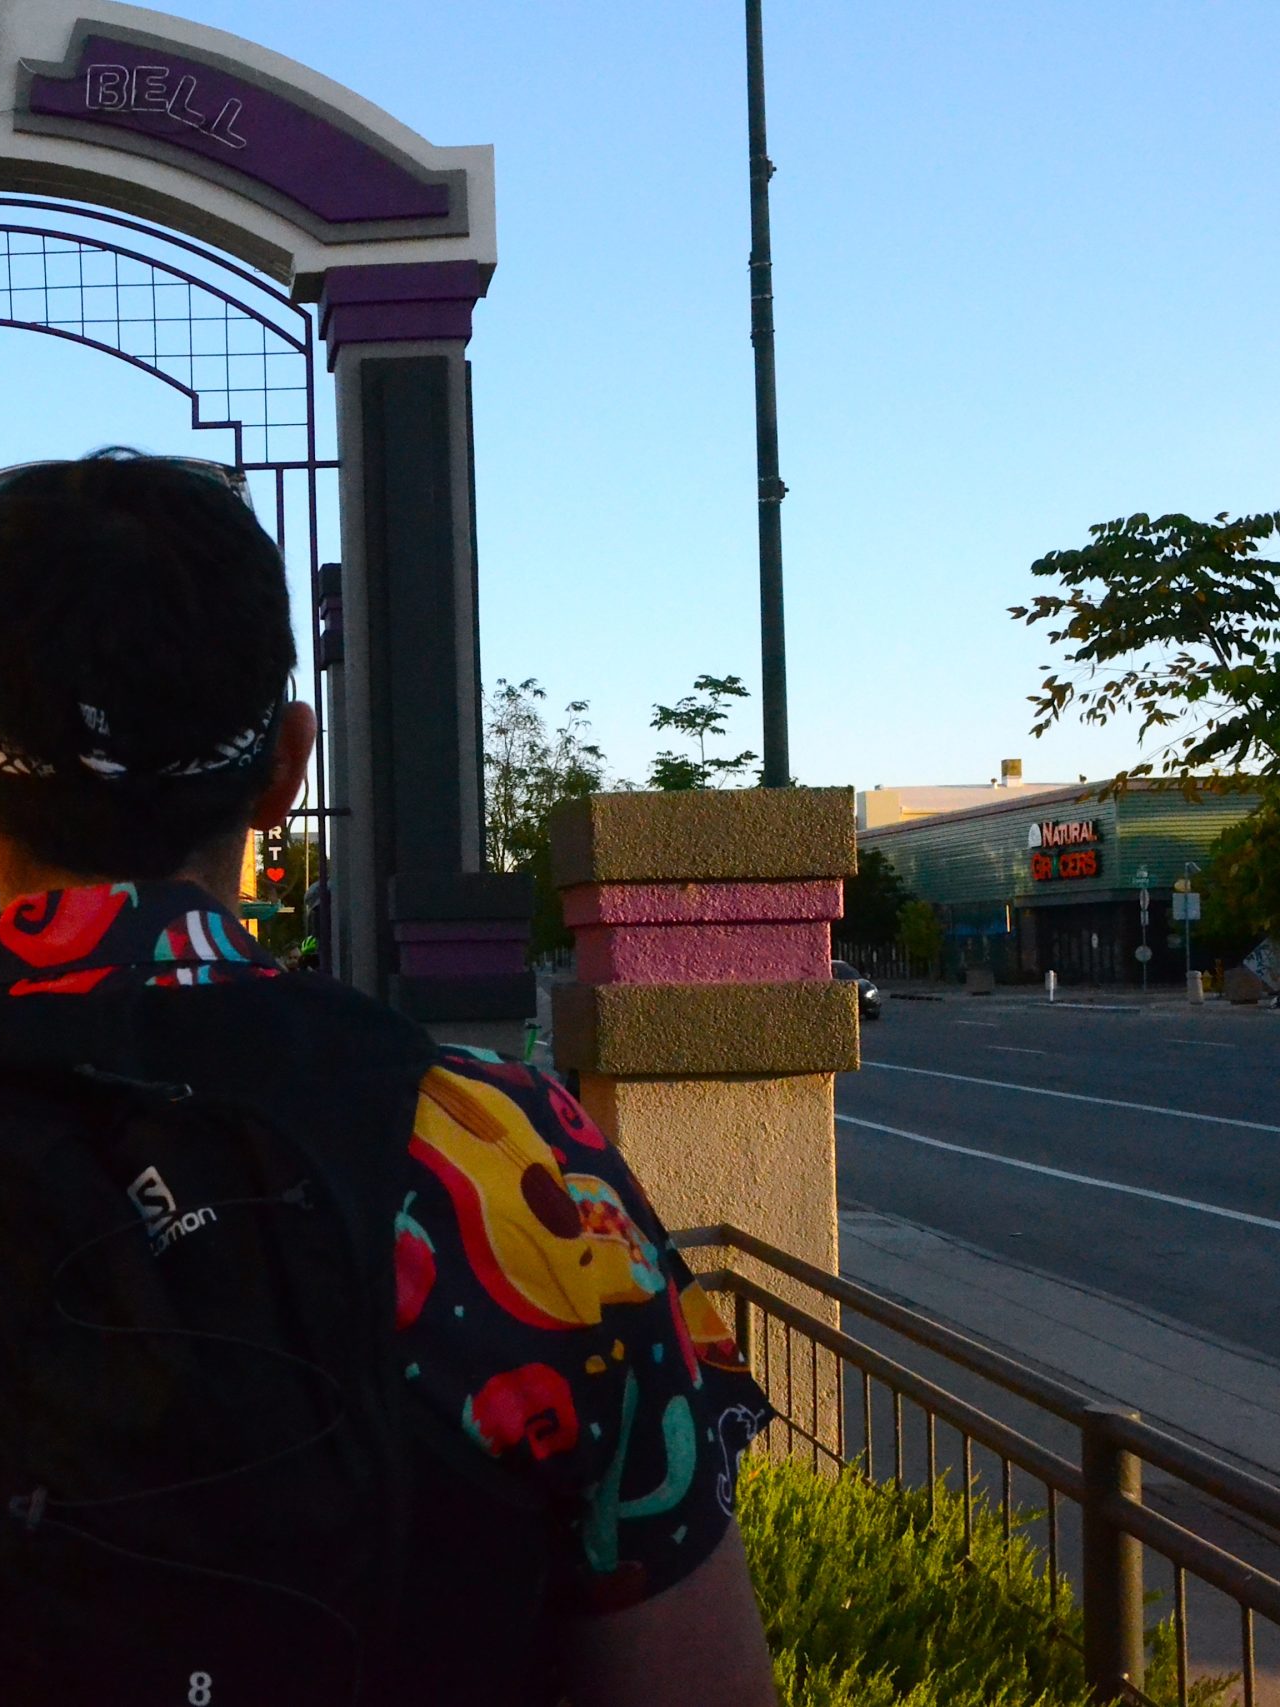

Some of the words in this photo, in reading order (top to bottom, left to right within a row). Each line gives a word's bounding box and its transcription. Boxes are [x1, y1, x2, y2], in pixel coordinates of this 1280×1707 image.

[86, 64, 247, 149] BELL
[1042, 821, 1097, 847] NATURAL
[188, 1671, 212, 1706] 8
